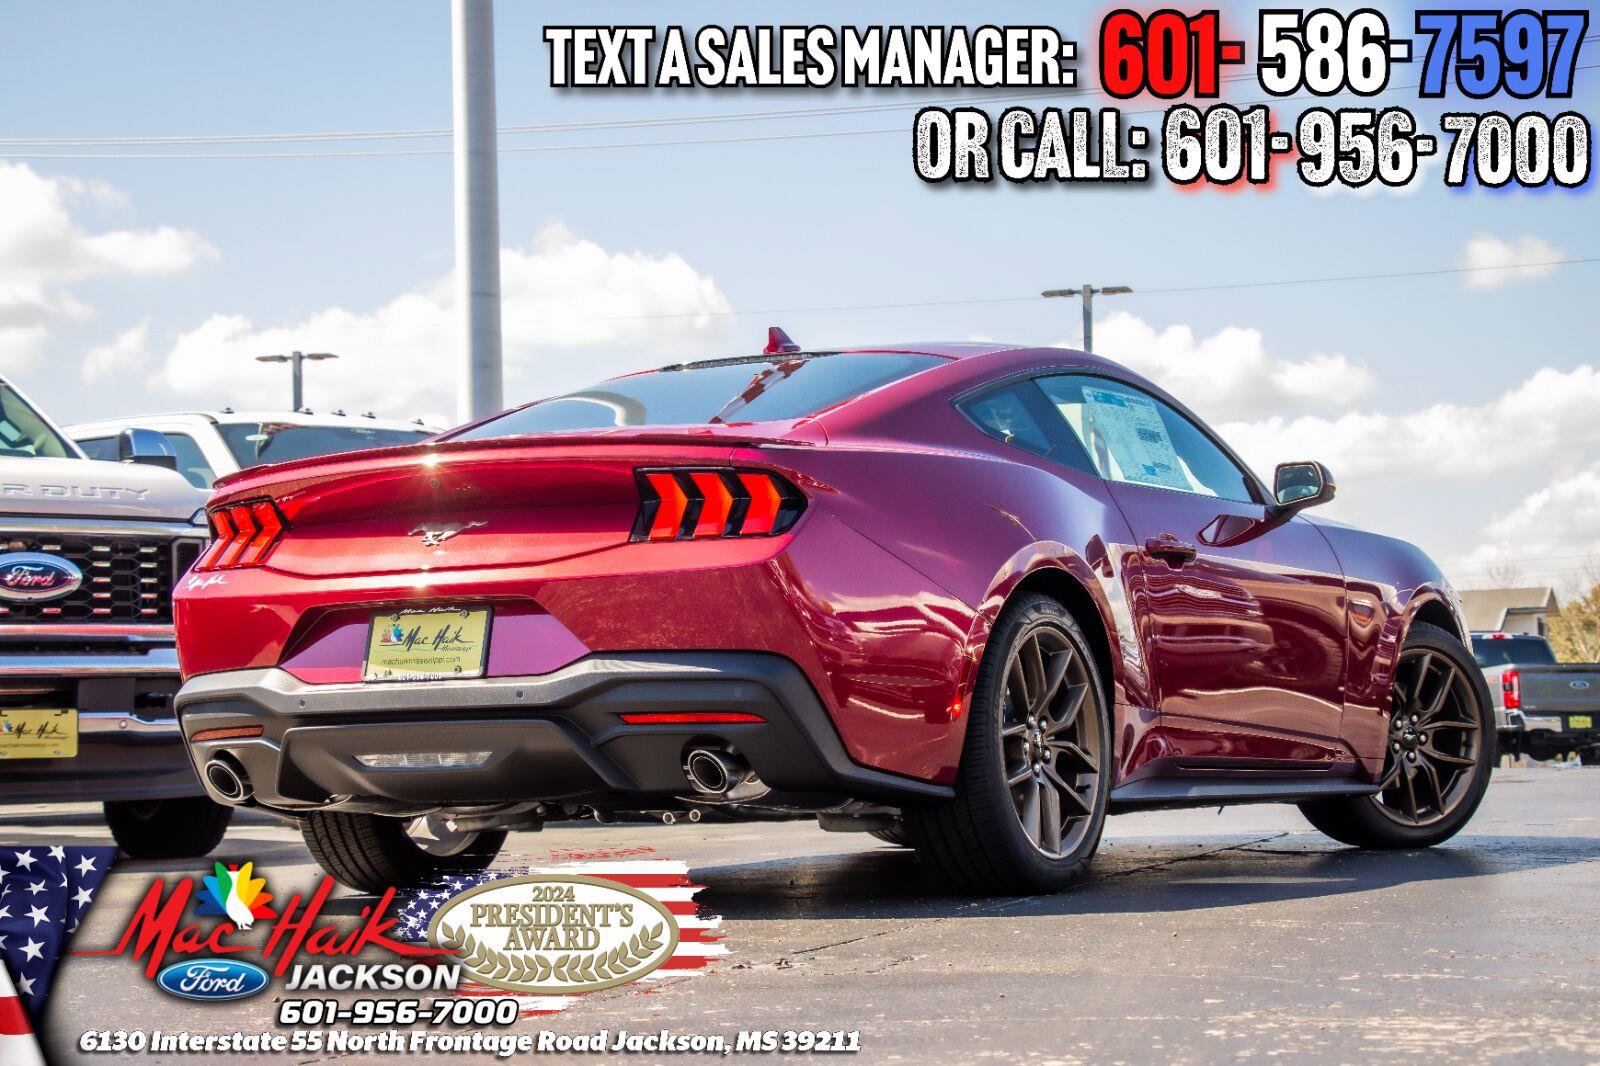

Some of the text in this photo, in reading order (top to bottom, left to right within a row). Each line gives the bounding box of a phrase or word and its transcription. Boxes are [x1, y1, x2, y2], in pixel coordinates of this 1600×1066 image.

[40, 484, 151, 500] DUTY
[7, 565, 55, 587] Ford
[402, 624, 474, 652] Mac Haik
